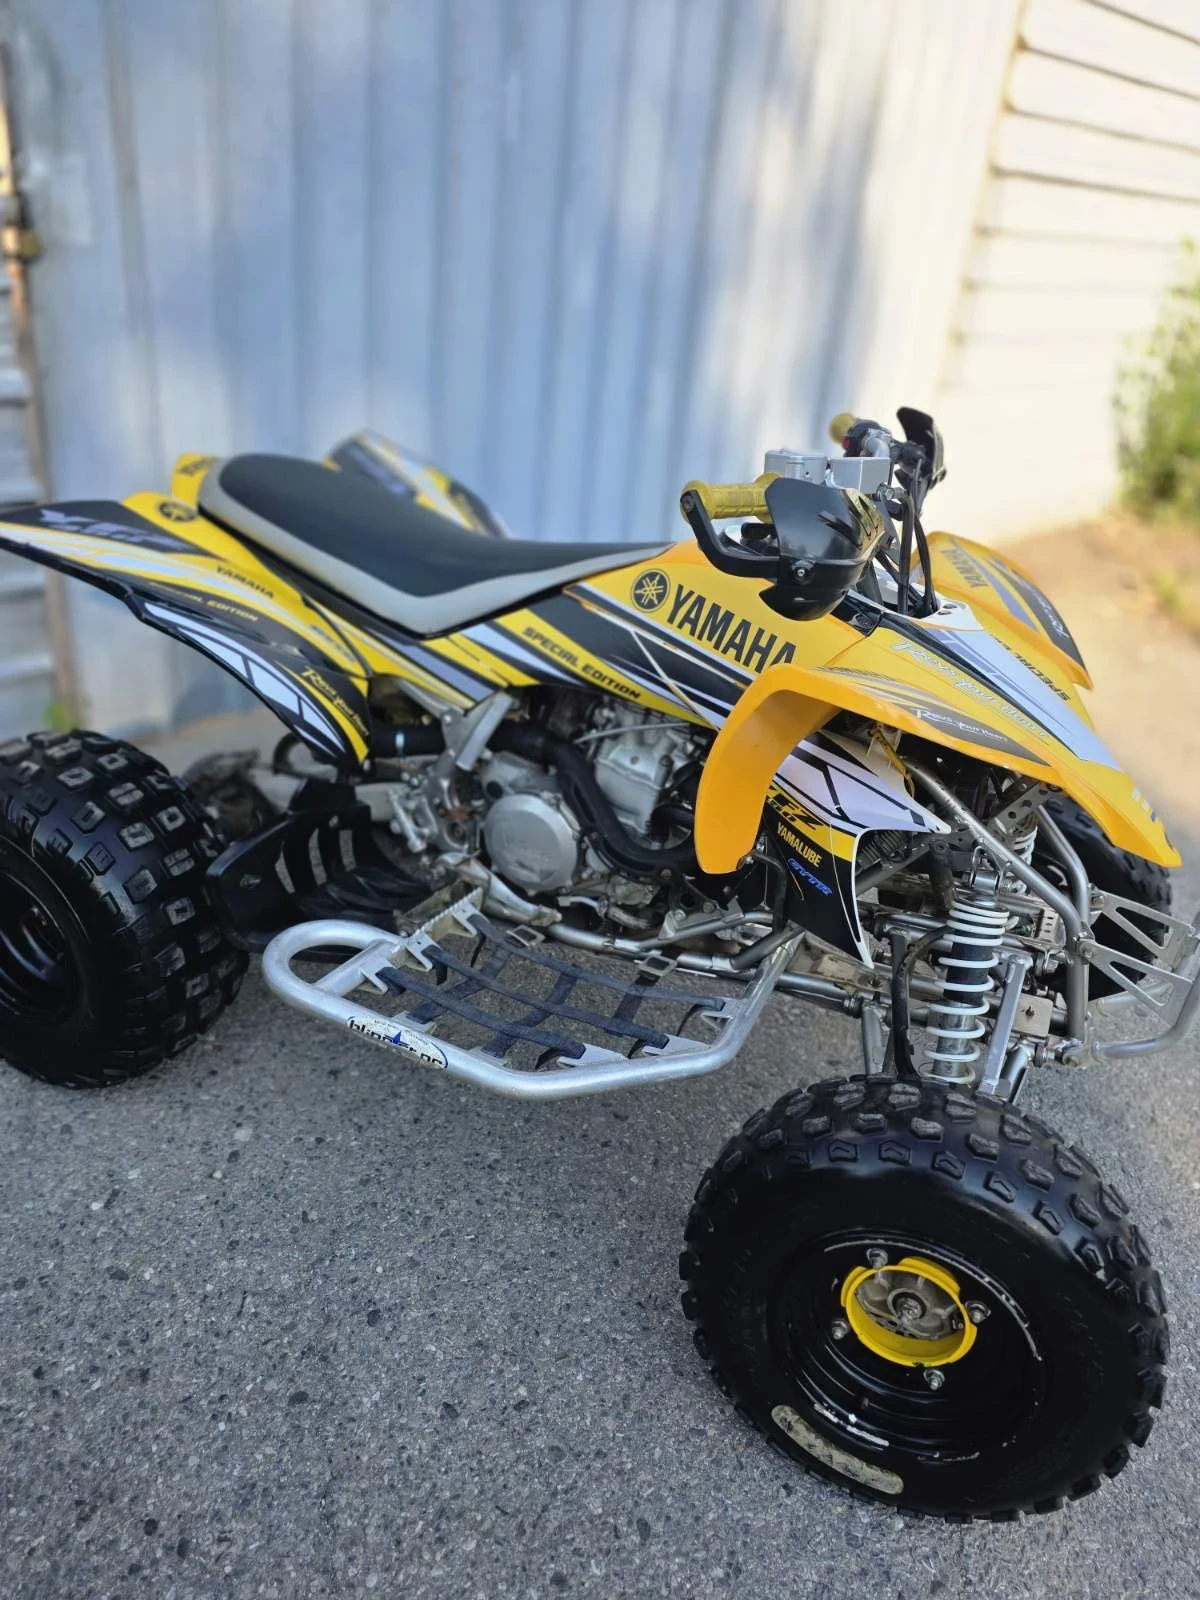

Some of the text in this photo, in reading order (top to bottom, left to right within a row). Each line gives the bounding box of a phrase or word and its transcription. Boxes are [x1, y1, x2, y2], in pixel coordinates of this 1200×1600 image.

[217, 565, 274, 599] YAMAHA
[667, 583, 797, 674] YAMAHA
[521, 626, 642, 700] SPECIAL EDITION
[776, 821, 823, 868] YAMALUBE
